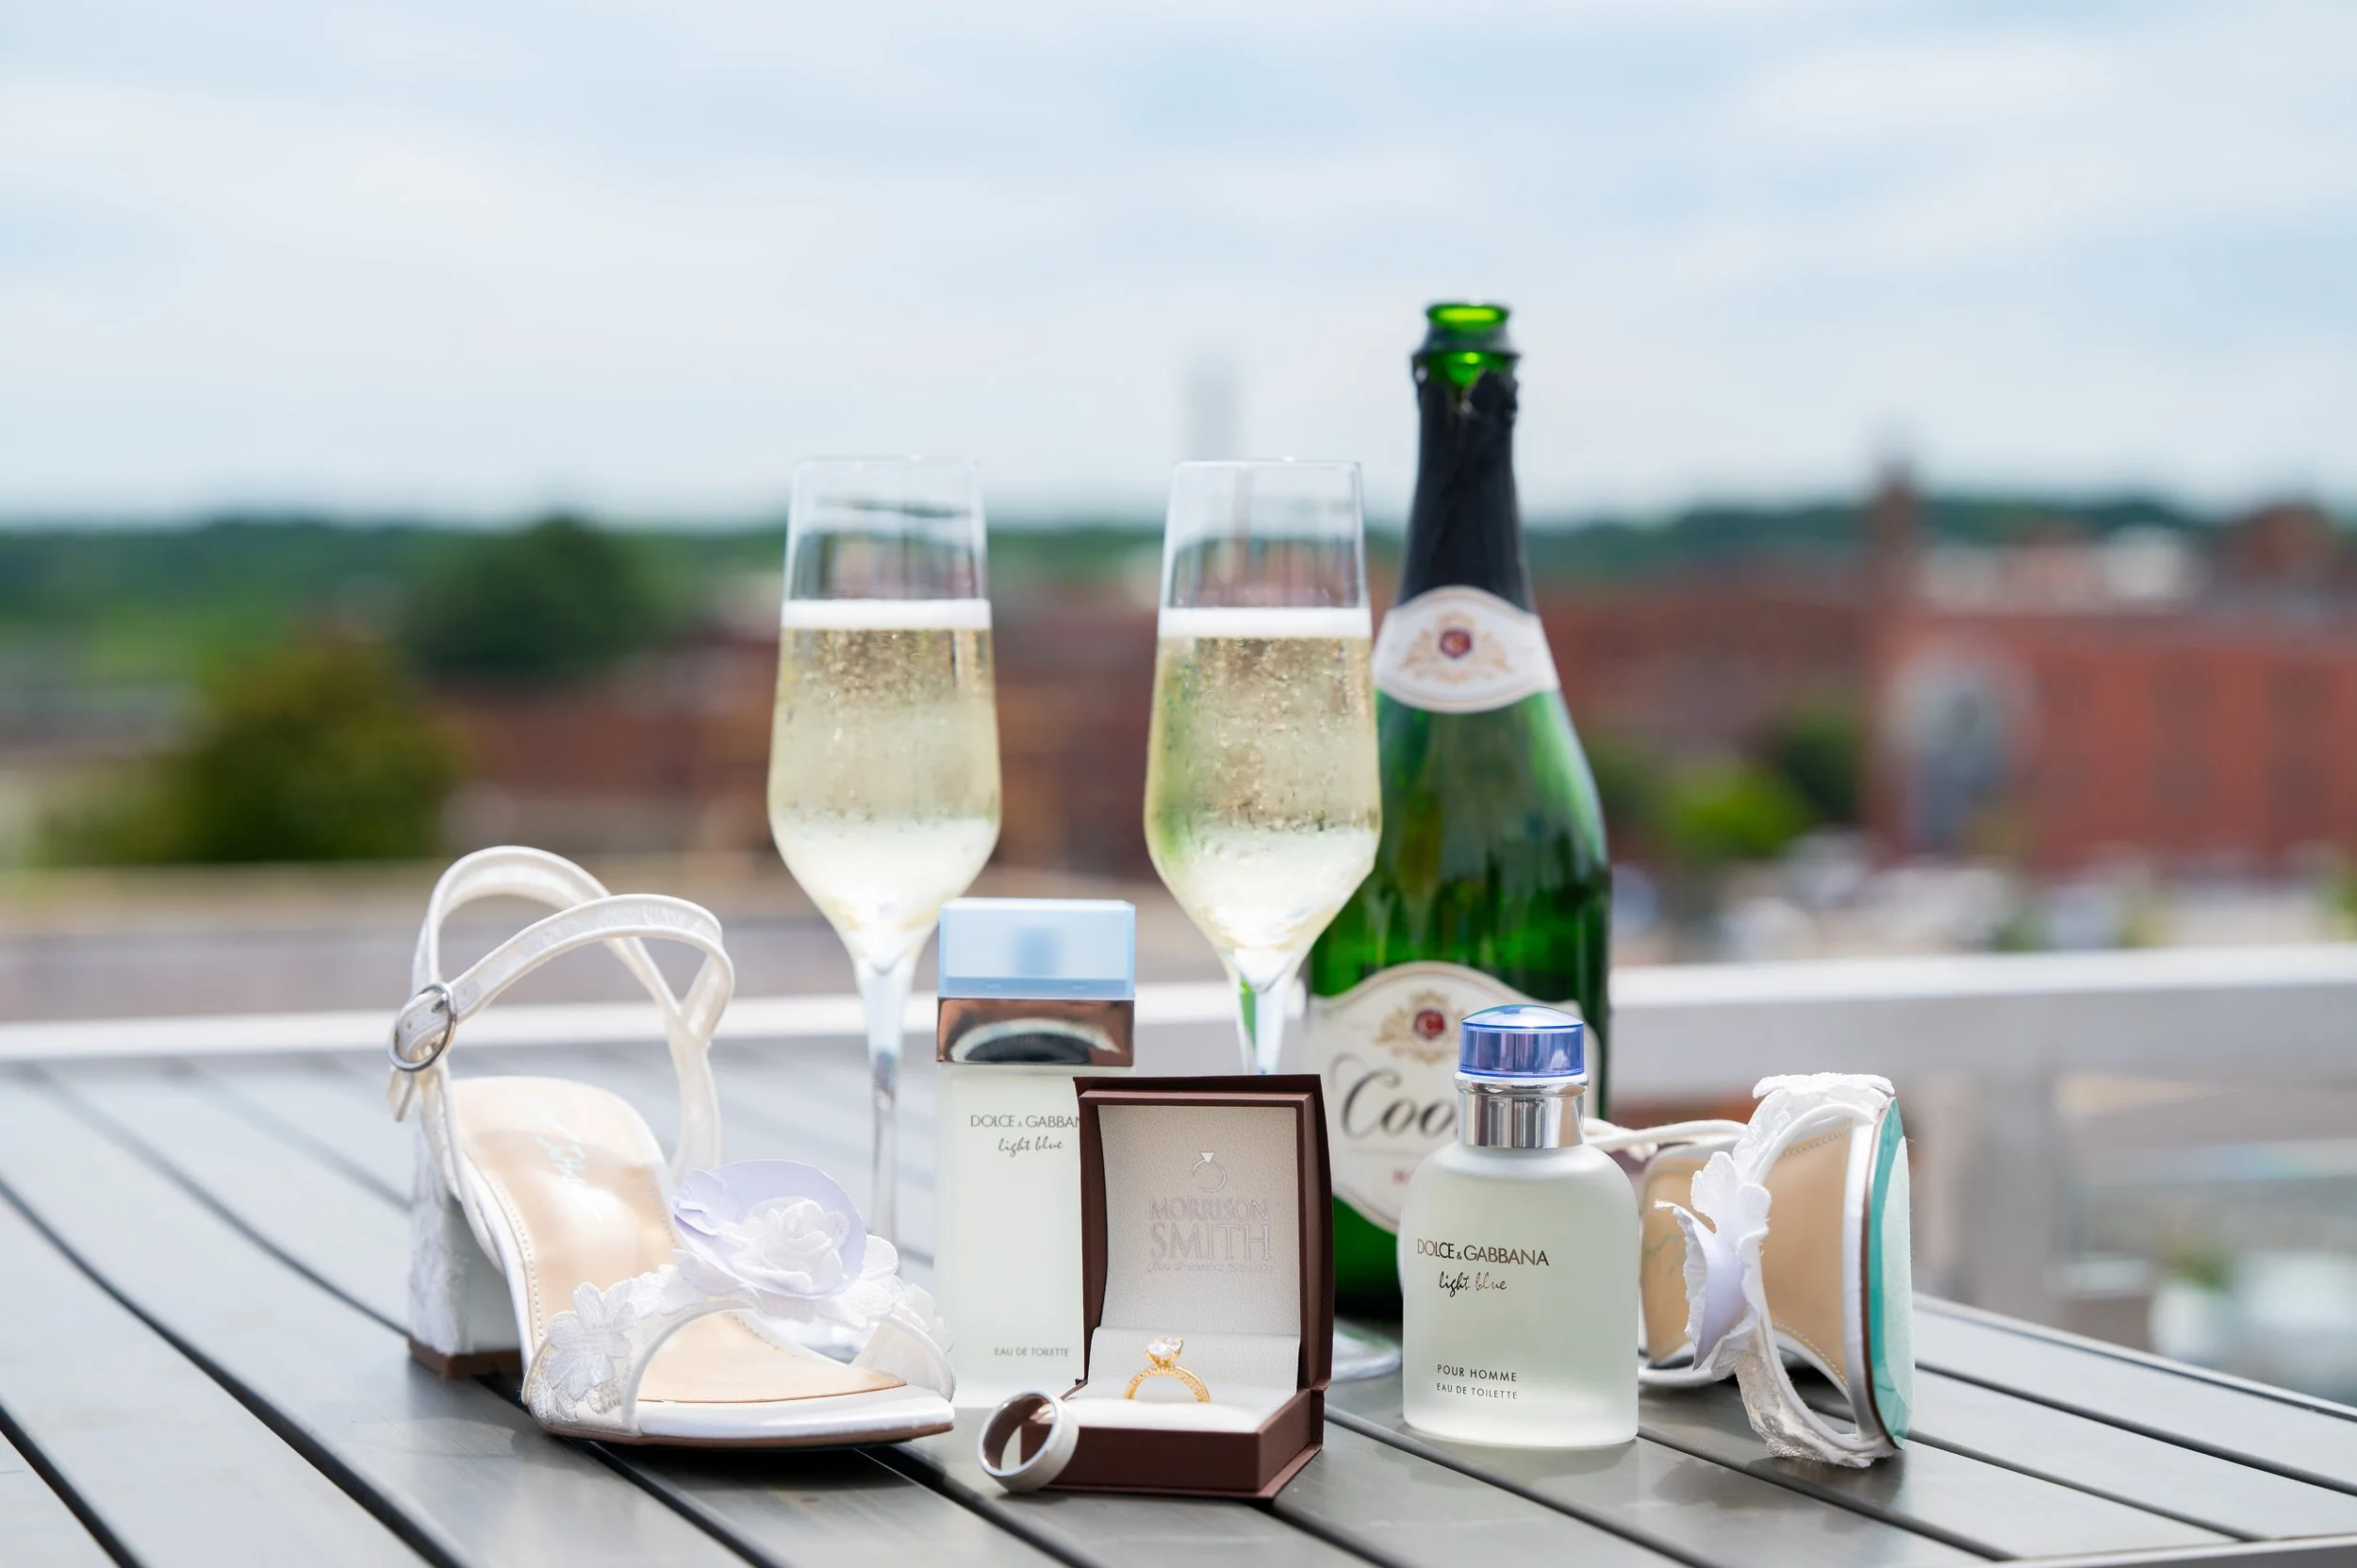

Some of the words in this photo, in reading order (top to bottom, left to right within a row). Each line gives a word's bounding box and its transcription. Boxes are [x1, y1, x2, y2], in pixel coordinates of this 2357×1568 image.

[1328, 1050, 1459, 1140] Coo
[970, 1114, 1015, 1128] DOLCE
[997, 1136, 1030, 1159] light
[1034, 1135, 1063, 1151] blue
[1149, 1197, 1270, 1222] MORRISON
[1149, 1222, 1270, 1261] SMITH
[1417, 1238, 1455, 1260] DOLCE
[1456, 1251, 1462, 1261] &
[1463, 1245, 1550, 1266] GABBANA
[1439, 1271, 1471, 1298] light
[1475, 1272, 1508, 1292] blue
[994, 1346, 1014, 1357] EAU
[1015, 1346, 1028, 1357] DE
[1030, 1346, 1070, 1358] TOILETTE
[1437, 1363, 1465, 1378] POUR
[1470, 1368, 1517, 1382] HOMME
[1436, 1382, 1453, 1394] EAU
[1456, 1385, 1467, 1395] DE
[1471, 1387, 1518, 1400] TOILETTE
